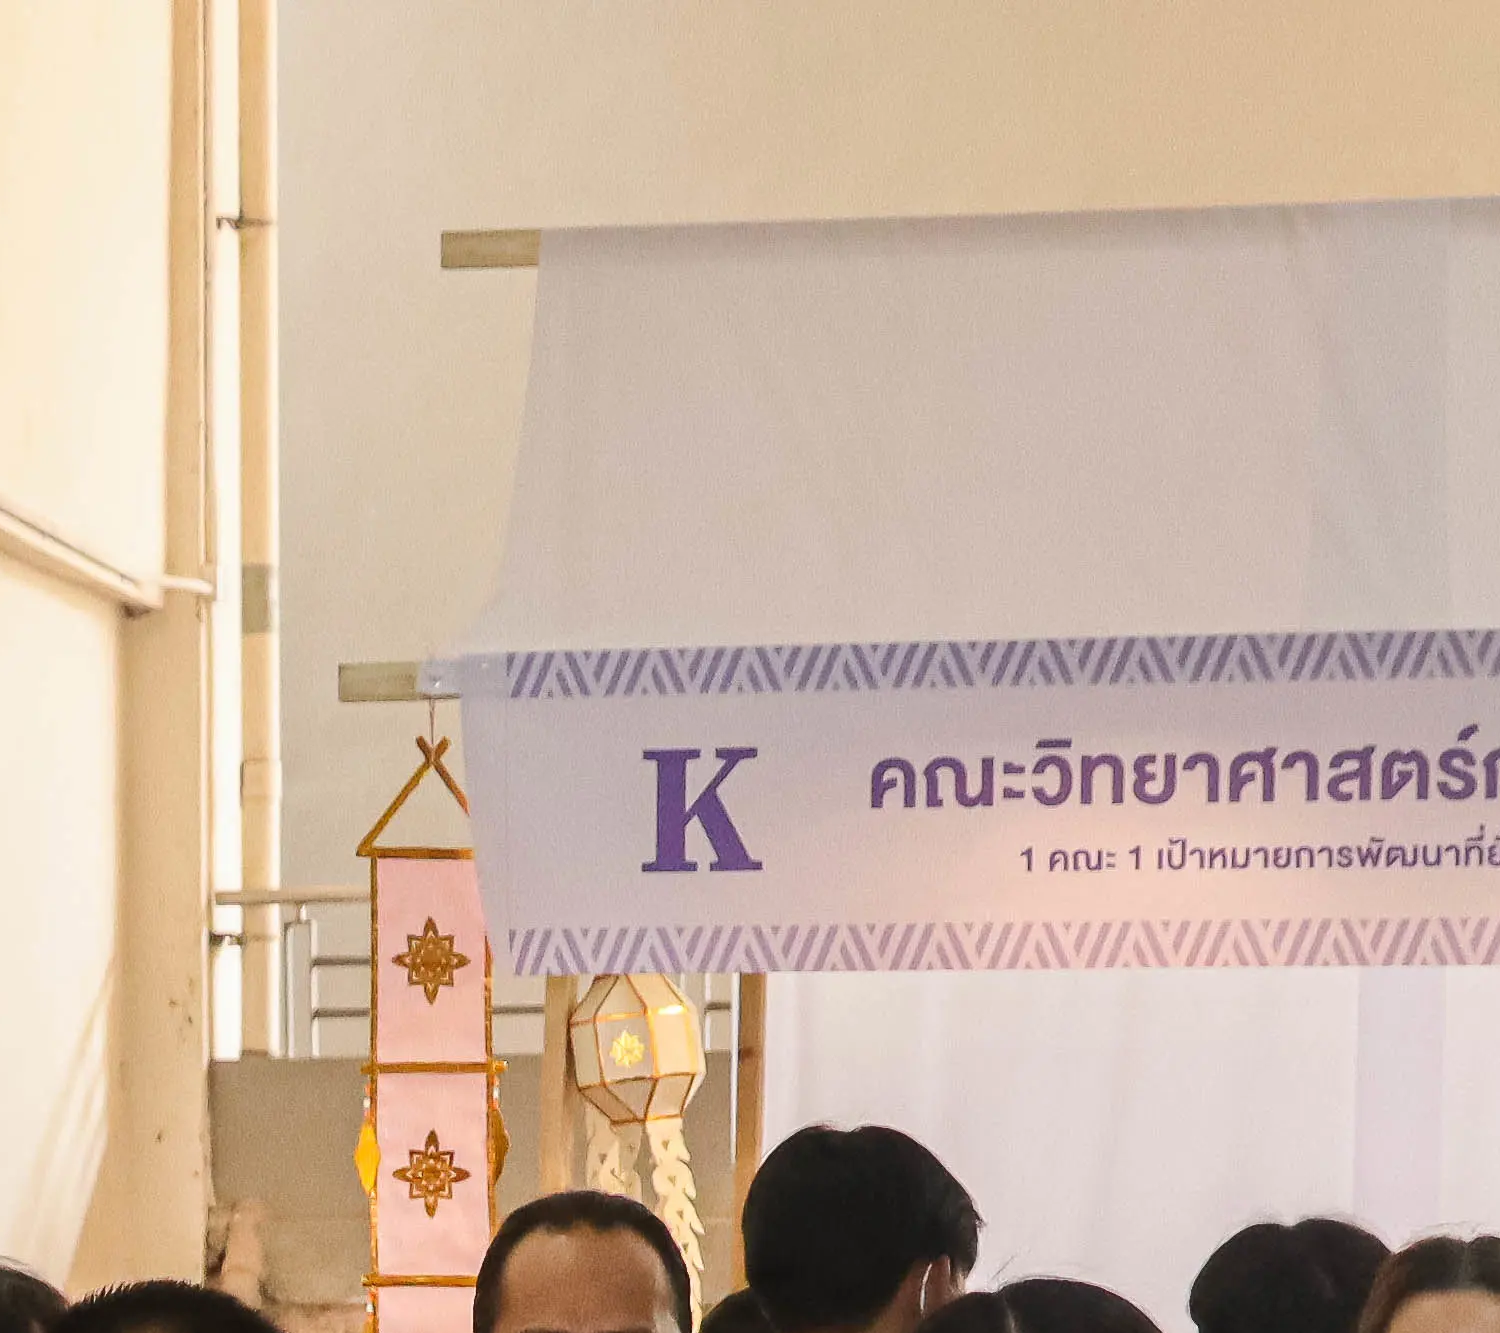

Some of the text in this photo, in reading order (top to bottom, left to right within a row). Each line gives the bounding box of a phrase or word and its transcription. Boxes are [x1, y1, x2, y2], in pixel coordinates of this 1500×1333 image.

[641, 746, 763, 873] K
[1020, 846, 1034, 872] 1
[1048, 848, 1116, 871] คณะ
[1131, 845, 1143, 871] 1
